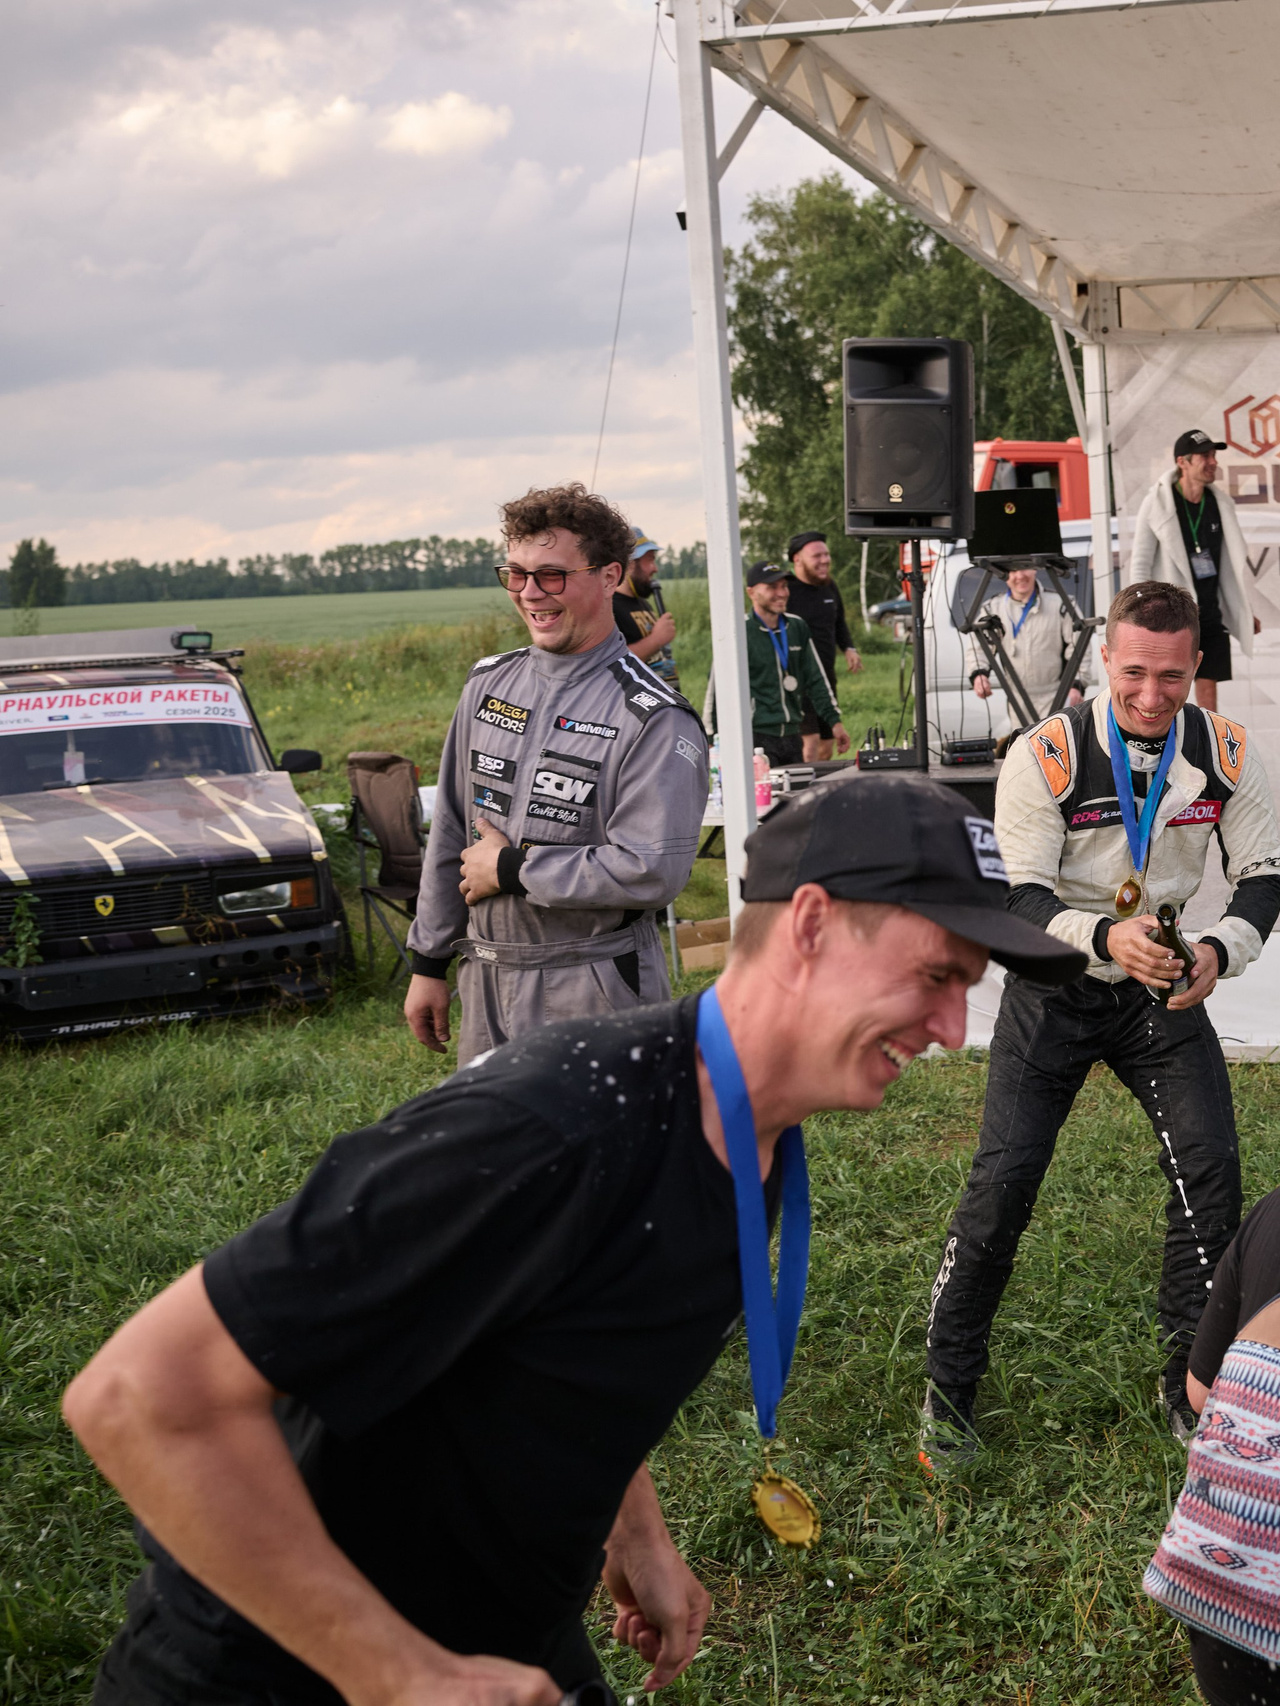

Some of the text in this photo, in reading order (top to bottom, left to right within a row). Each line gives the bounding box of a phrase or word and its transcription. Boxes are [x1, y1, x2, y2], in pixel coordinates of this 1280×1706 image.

[0, 688, 229, 713] РНАУЛЬСКОЙ РАКЕТЫ
[165, 706, 236, 717] СЕЗОН 2025
[487, 699, 528, 720] OMEGA
[476, 708, 526, 733] MOTORS
[477, 754, 505, 771] SSP
[1071, 809, 1101, 825] RDS
[1175, 805, 1217, 820] EBOIL
